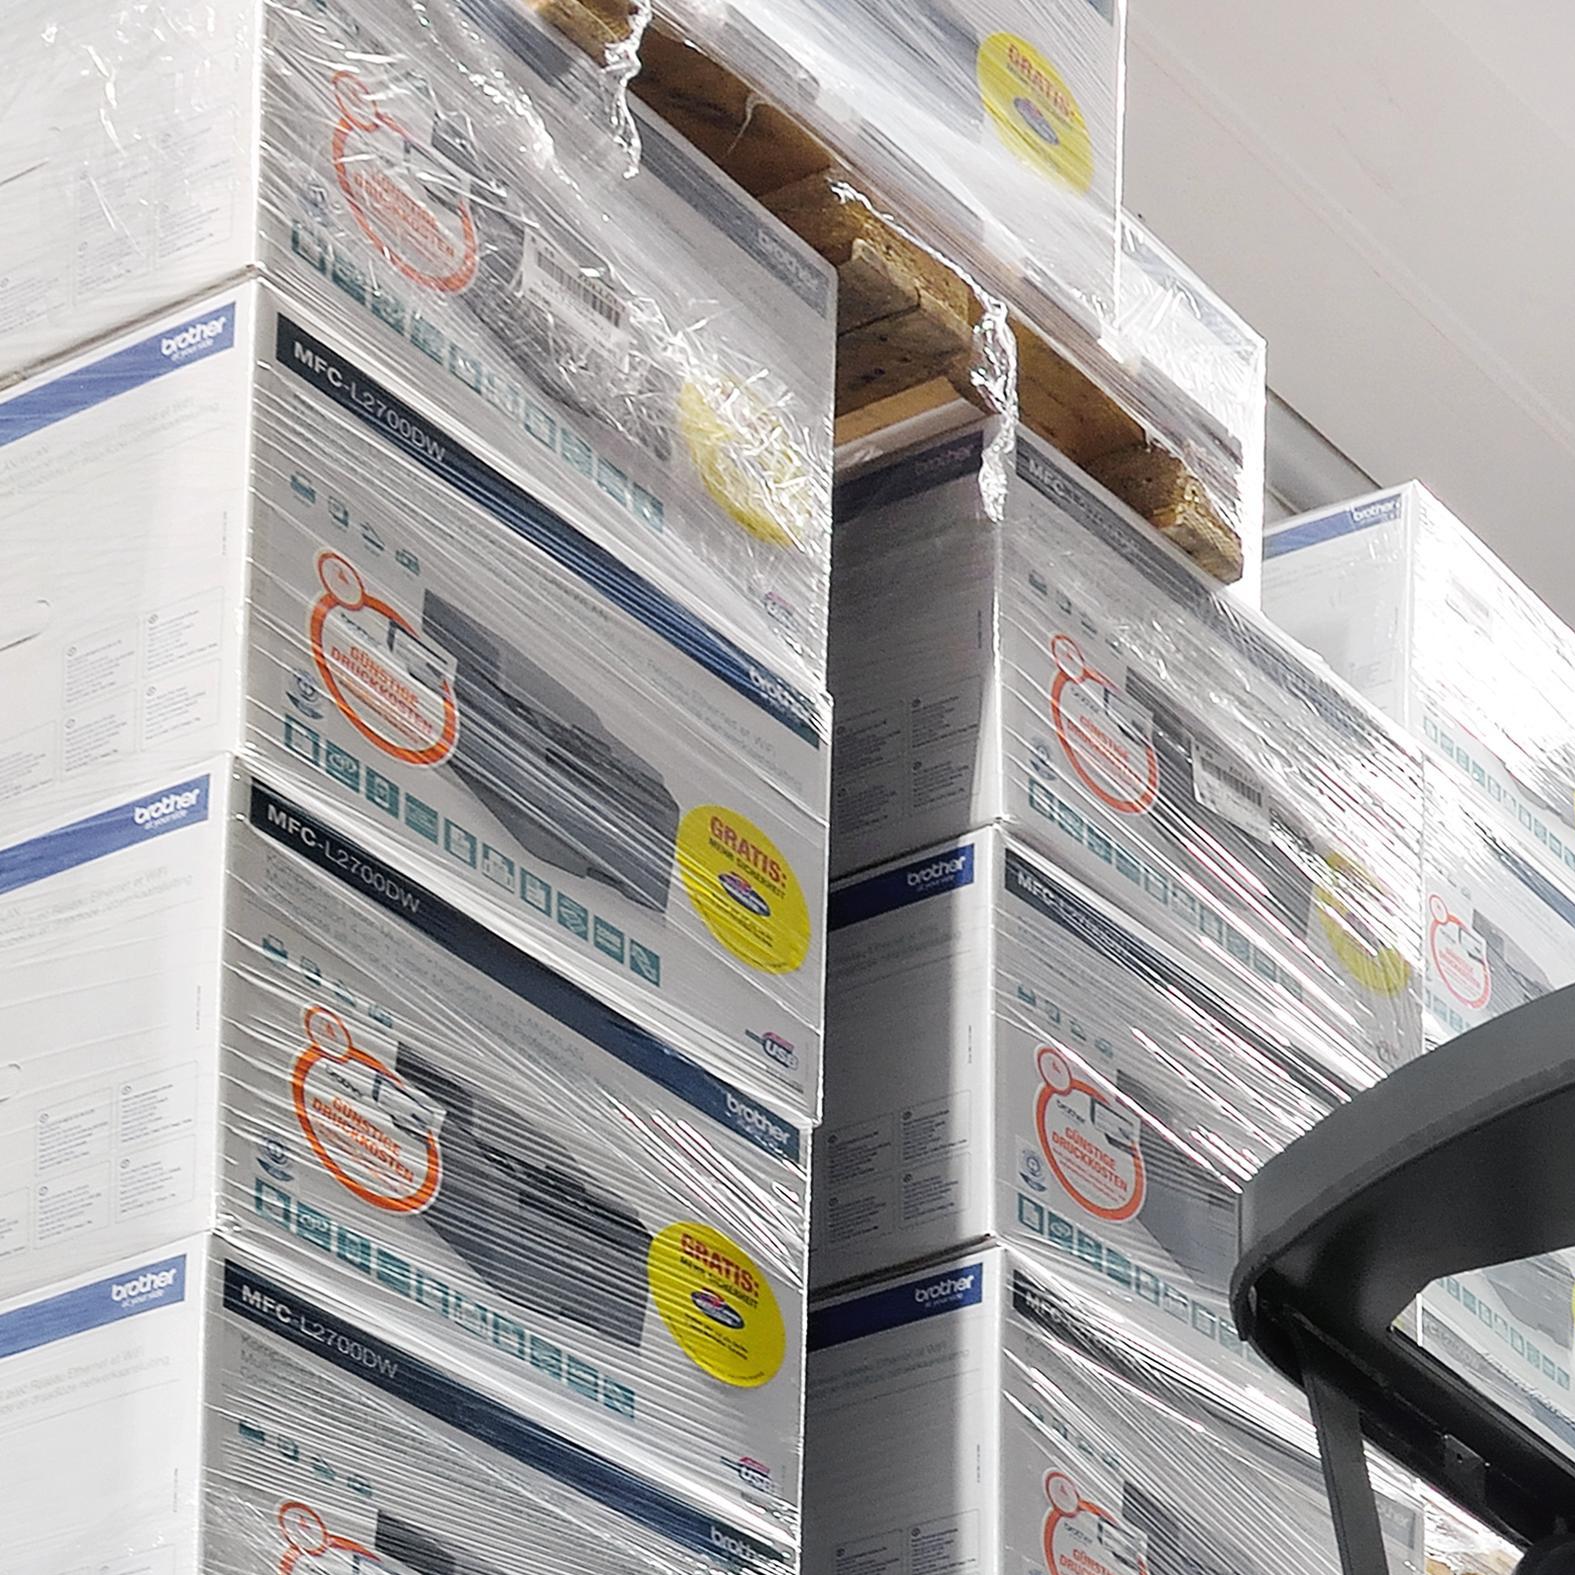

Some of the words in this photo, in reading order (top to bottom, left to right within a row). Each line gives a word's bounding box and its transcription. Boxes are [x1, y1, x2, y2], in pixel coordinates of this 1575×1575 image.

[160, 315, 228, 358] brother
[292, 338, 449, 464] MFC-L2700DW
[133, 788, 201, 826] brother
[266, 805, 421, 914] MFC-L2700DW
[709, 814, 788, 890] GRATIS:
[905, 854, 967, 889] brother
[765, 1038, 800, 1070] USB
[725, 1092, 793, 1146] brother
[110, 1267, 178, 1303] brother
[679, 1233, 761, 1299] GRATIS:
[913, 1274, 975, 1305] brother
[241, 1284, 400, 1381] MFC-L2700DW
